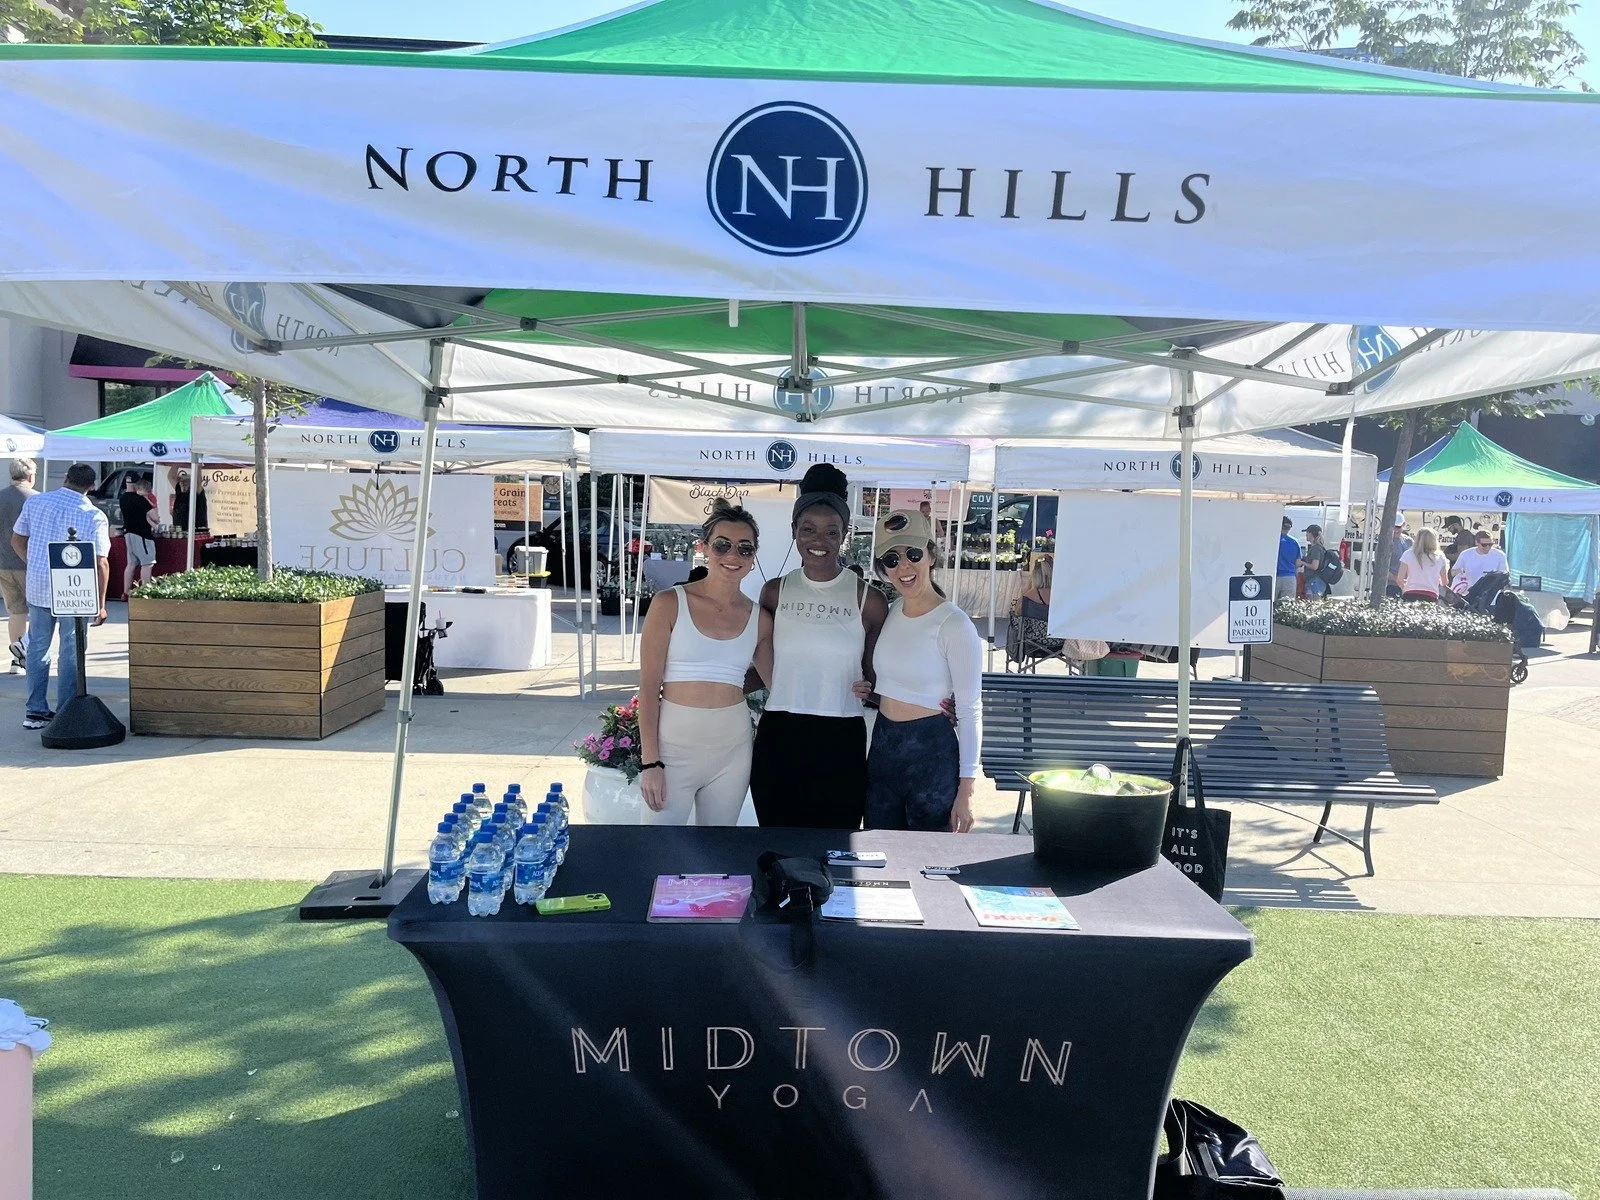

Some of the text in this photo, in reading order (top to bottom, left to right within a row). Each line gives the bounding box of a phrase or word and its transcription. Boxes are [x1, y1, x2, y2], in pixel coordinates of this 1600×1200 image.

[367, 144, 1211, 224] NORTH NH HILLS
[300, 432, 467, 449] NORTH NH HLLS
[108, 446, 144, 454] NORTH
[699, 449, 863, 465] NORTH NH HILLS
[1103, 461, 1160, 472] NORTH
[1212, 463, 1267, 476] HILLS
[212, 470, 250, 483] Rose's
[689, 484, 724, 499] Black
[1454, 494, 1489, 502] NORTH
[972, 494, 1005, 504] COVS
[67, 575, 82, 587] 10
[57, 589, 92, 597] MINUTE
[56, 600, 94, 608] PARKING
[780, 602, 852, 617] MIDTOWN
[797, 612, 831, 620] YOGA
[1245, 606, 1258, 617] 10
[1234, 619, 1266, 627] MINUTE
[1232, 628, 1268, 636] PARKING
[1171, 826, 1198, 840] IT'S
[1170, 844, 1197, 857] ALL
[1173, 861, 1204, 874] OOD
[571, 1026, 1073, 1085] MIDTOWN
[707, 1083, 934, 1114] YOGA
